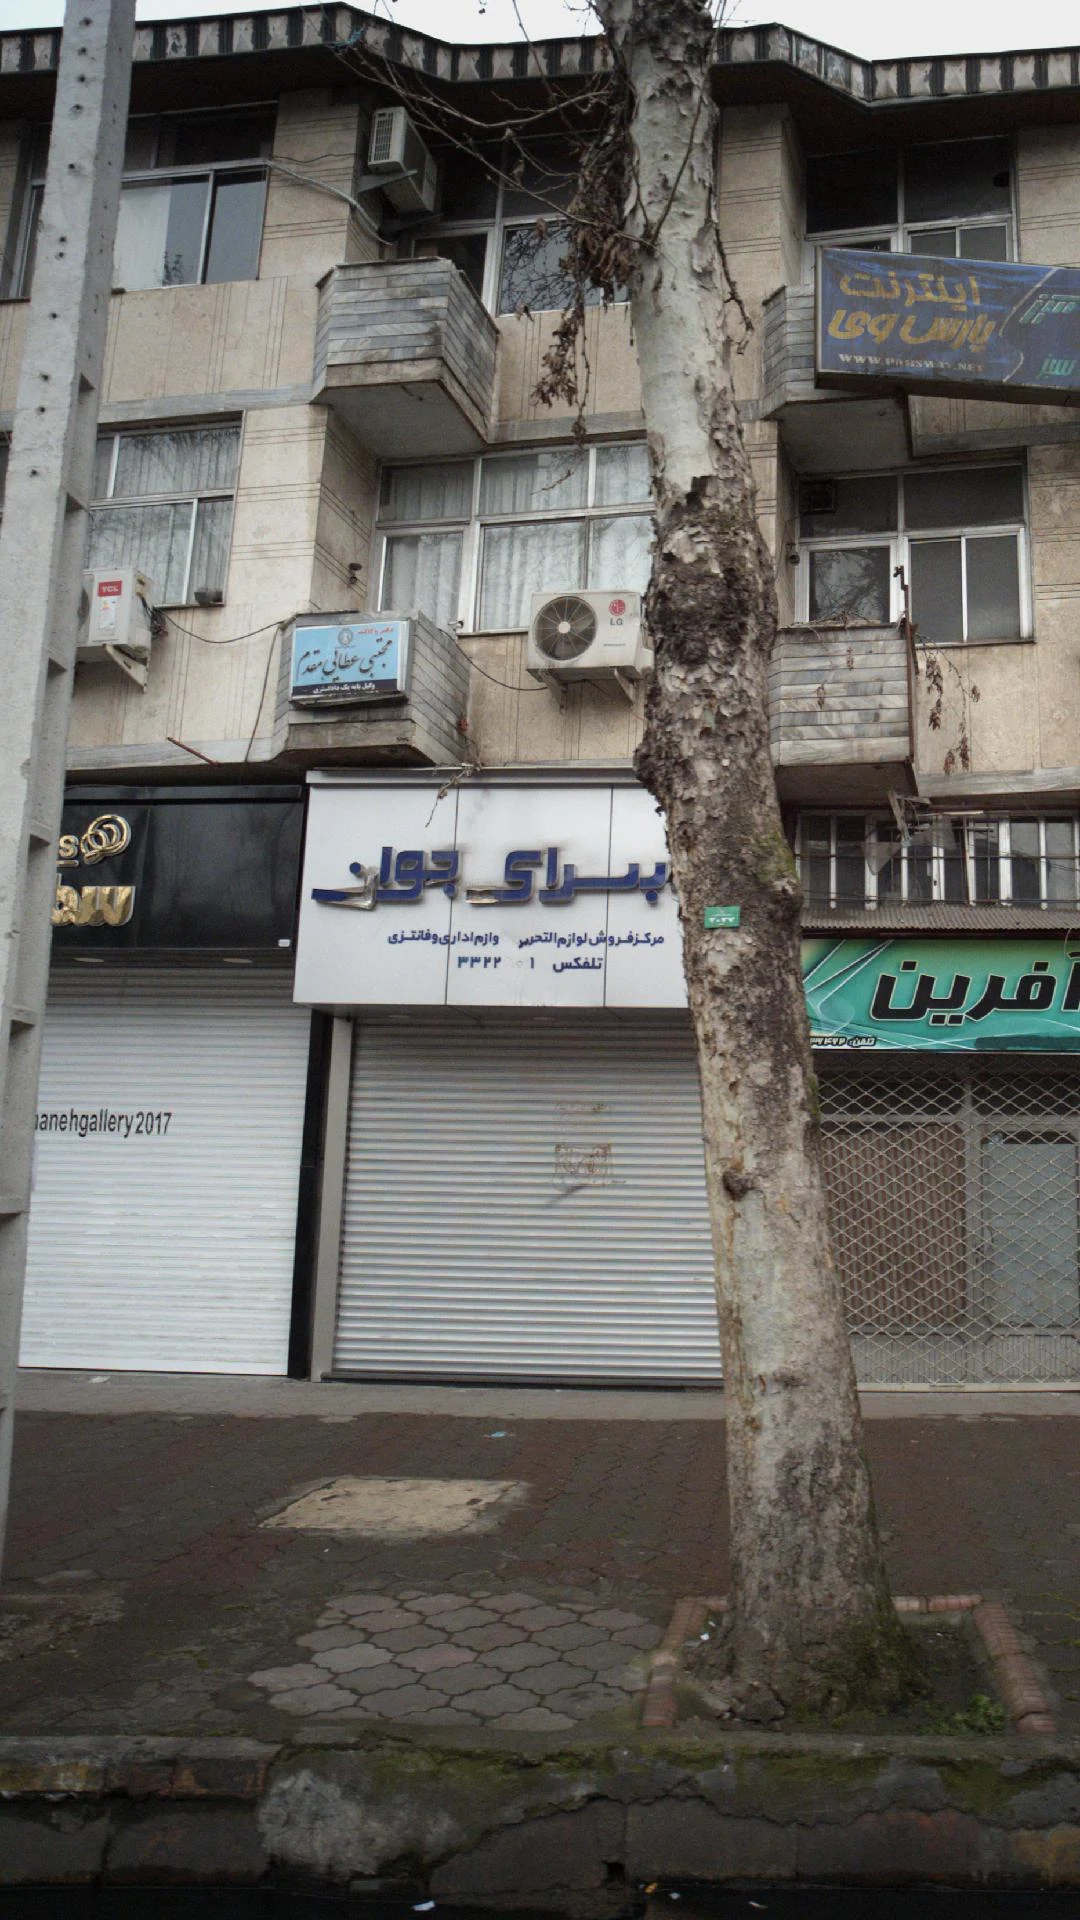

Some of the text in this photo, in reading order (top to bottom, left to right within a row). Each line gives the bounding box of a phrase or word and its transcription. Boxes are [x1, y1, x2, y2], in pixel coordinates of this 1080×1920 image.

[840, 271, 981, 312] اینترنت
[900, 314, 996, 352] پارس
[102, 585, 119, 593] TCL
[609, 618, 624, 626] LG
[311, 846, 460, 910] جوان
[589, 929, 633, 947] فروش
[632, 932, 665, 947] مرکز
[553, 957, 603, 972] تلفکس
